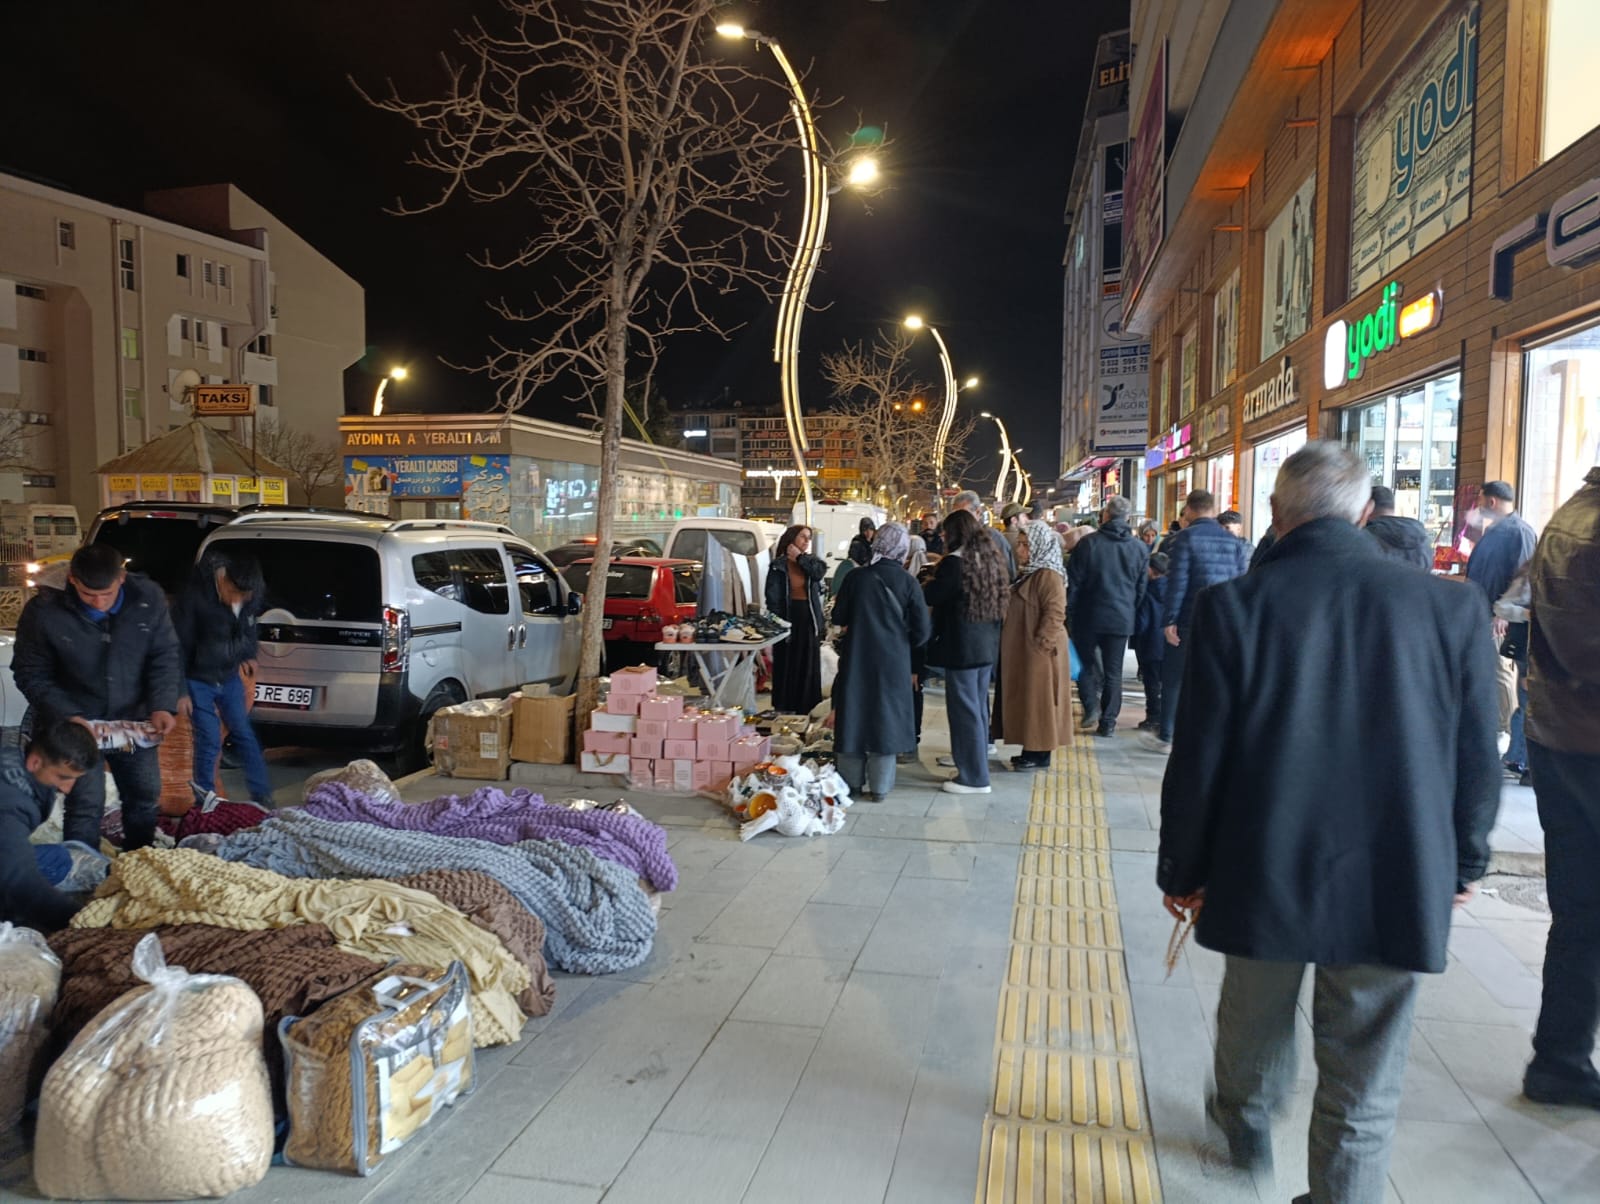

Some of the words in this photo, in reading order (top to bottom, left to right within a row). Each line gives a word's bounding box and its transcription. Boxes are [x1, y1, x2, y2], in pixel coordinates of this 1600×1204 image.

[1396, 5, 1478, 198] yodi
[1347, 281, 1398, 379] yodi
[1243, 356, 1294, 423] armada
[346, 432, 382, 445] AYDIN
[423, 431, 471, 445] YERALTI
[394, 459, 425, 473] YERALTI
[213, 481, 230, 492] VAN
[264, 687, 283, 701] RE
[287, 689, 310, 703] 696
